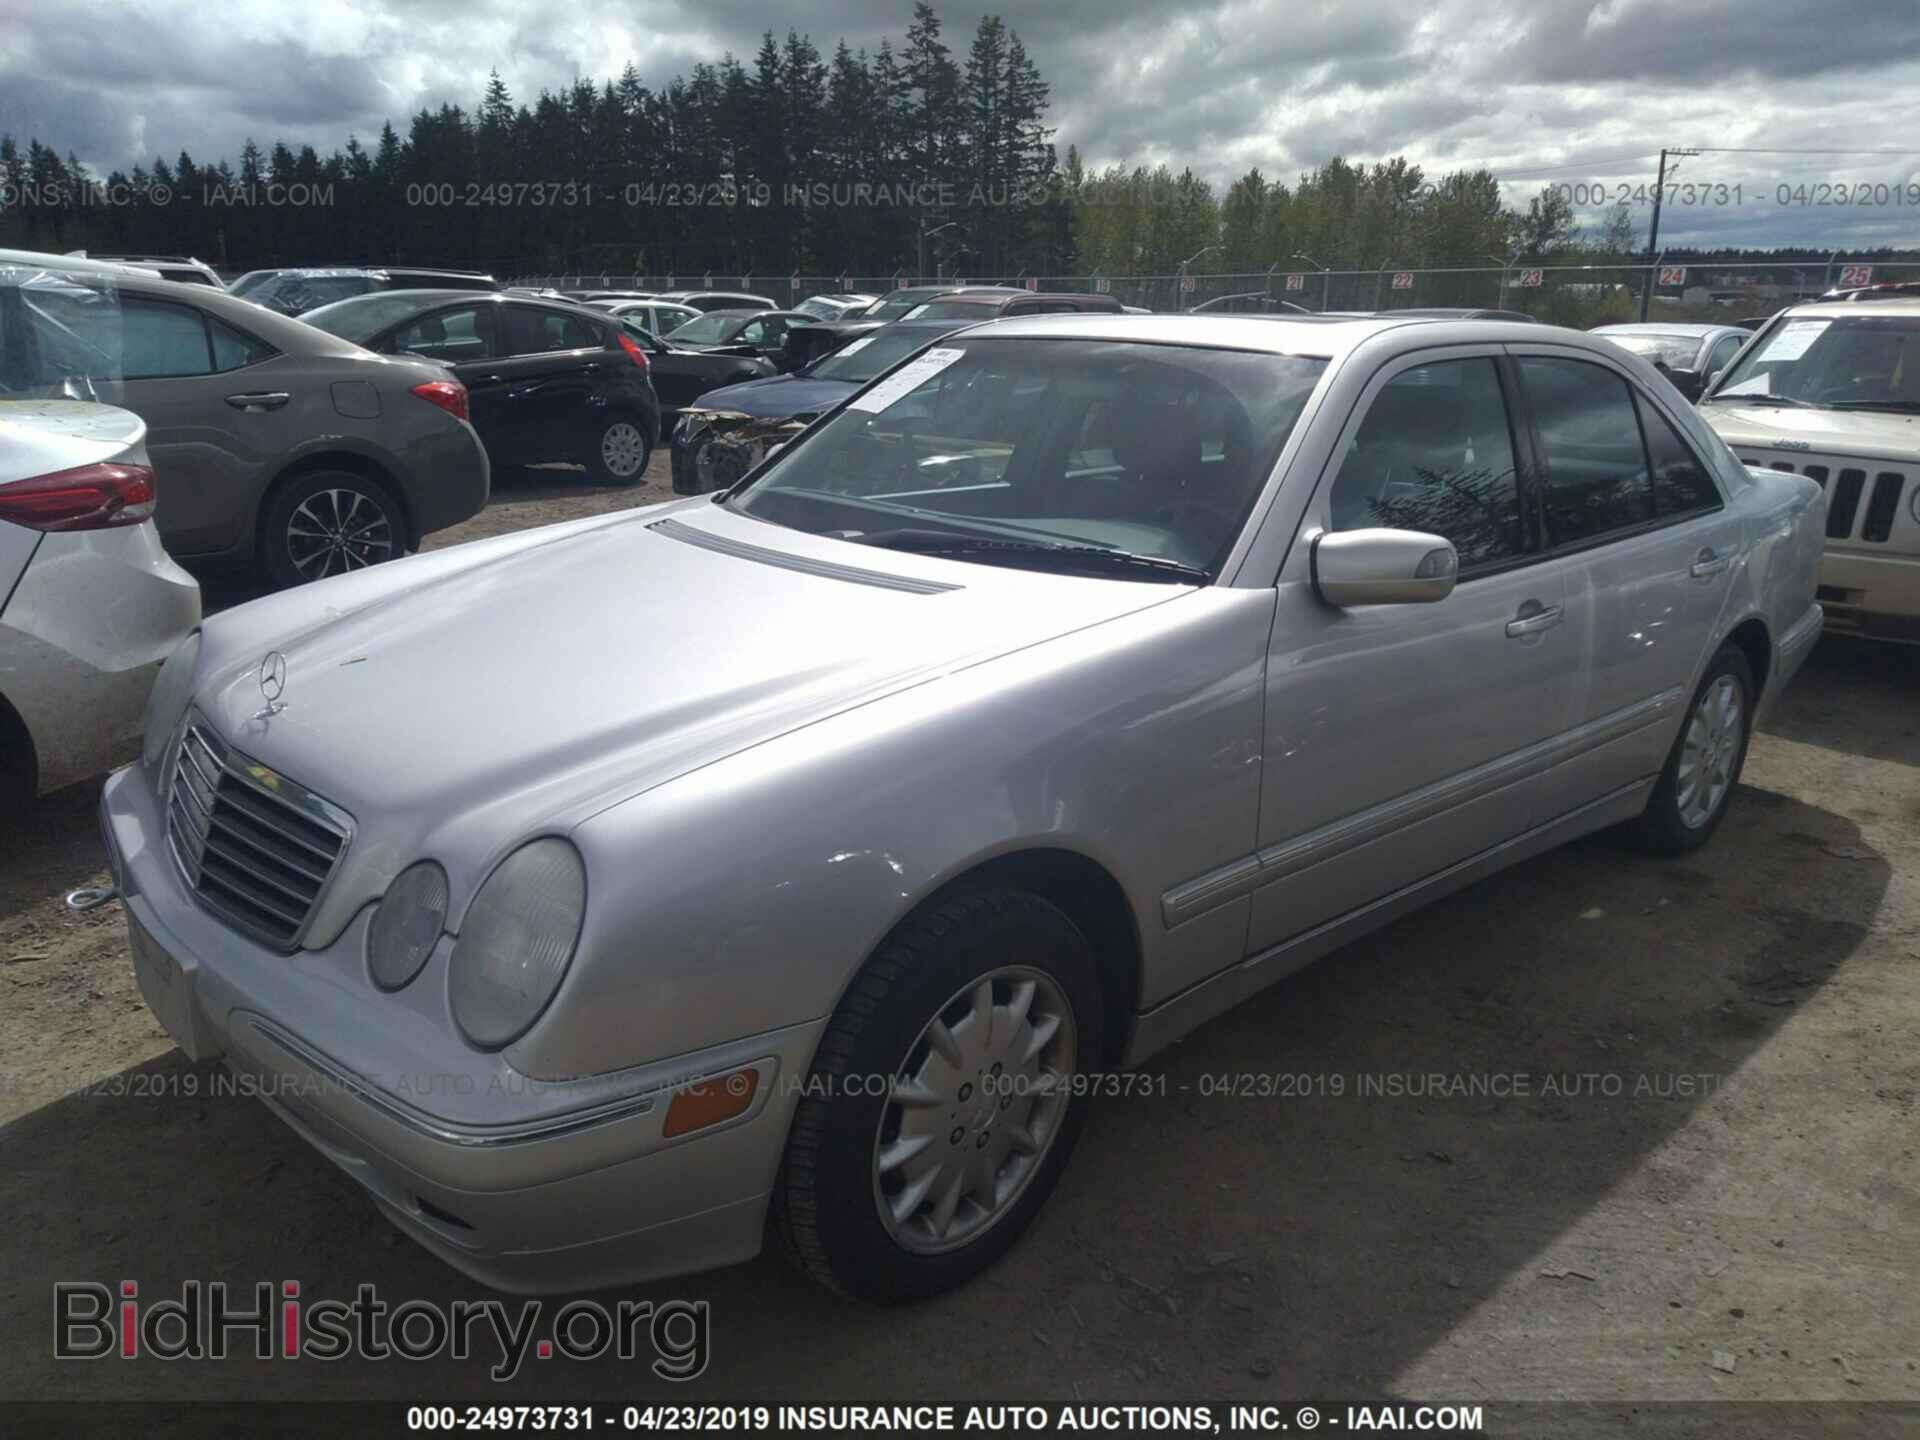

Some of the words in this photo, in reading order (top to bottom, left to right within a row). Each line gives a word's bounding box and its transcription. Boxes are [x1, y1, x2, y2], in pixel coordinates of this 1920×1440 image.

[1288, 274, 1303, 289] 21
[1393, 273, 1413, 287] 22
[1521, 270, 1541, 286] 23
[1661, 266, 1683, 284] 24
[1842, 266, 1868, 285] 25
